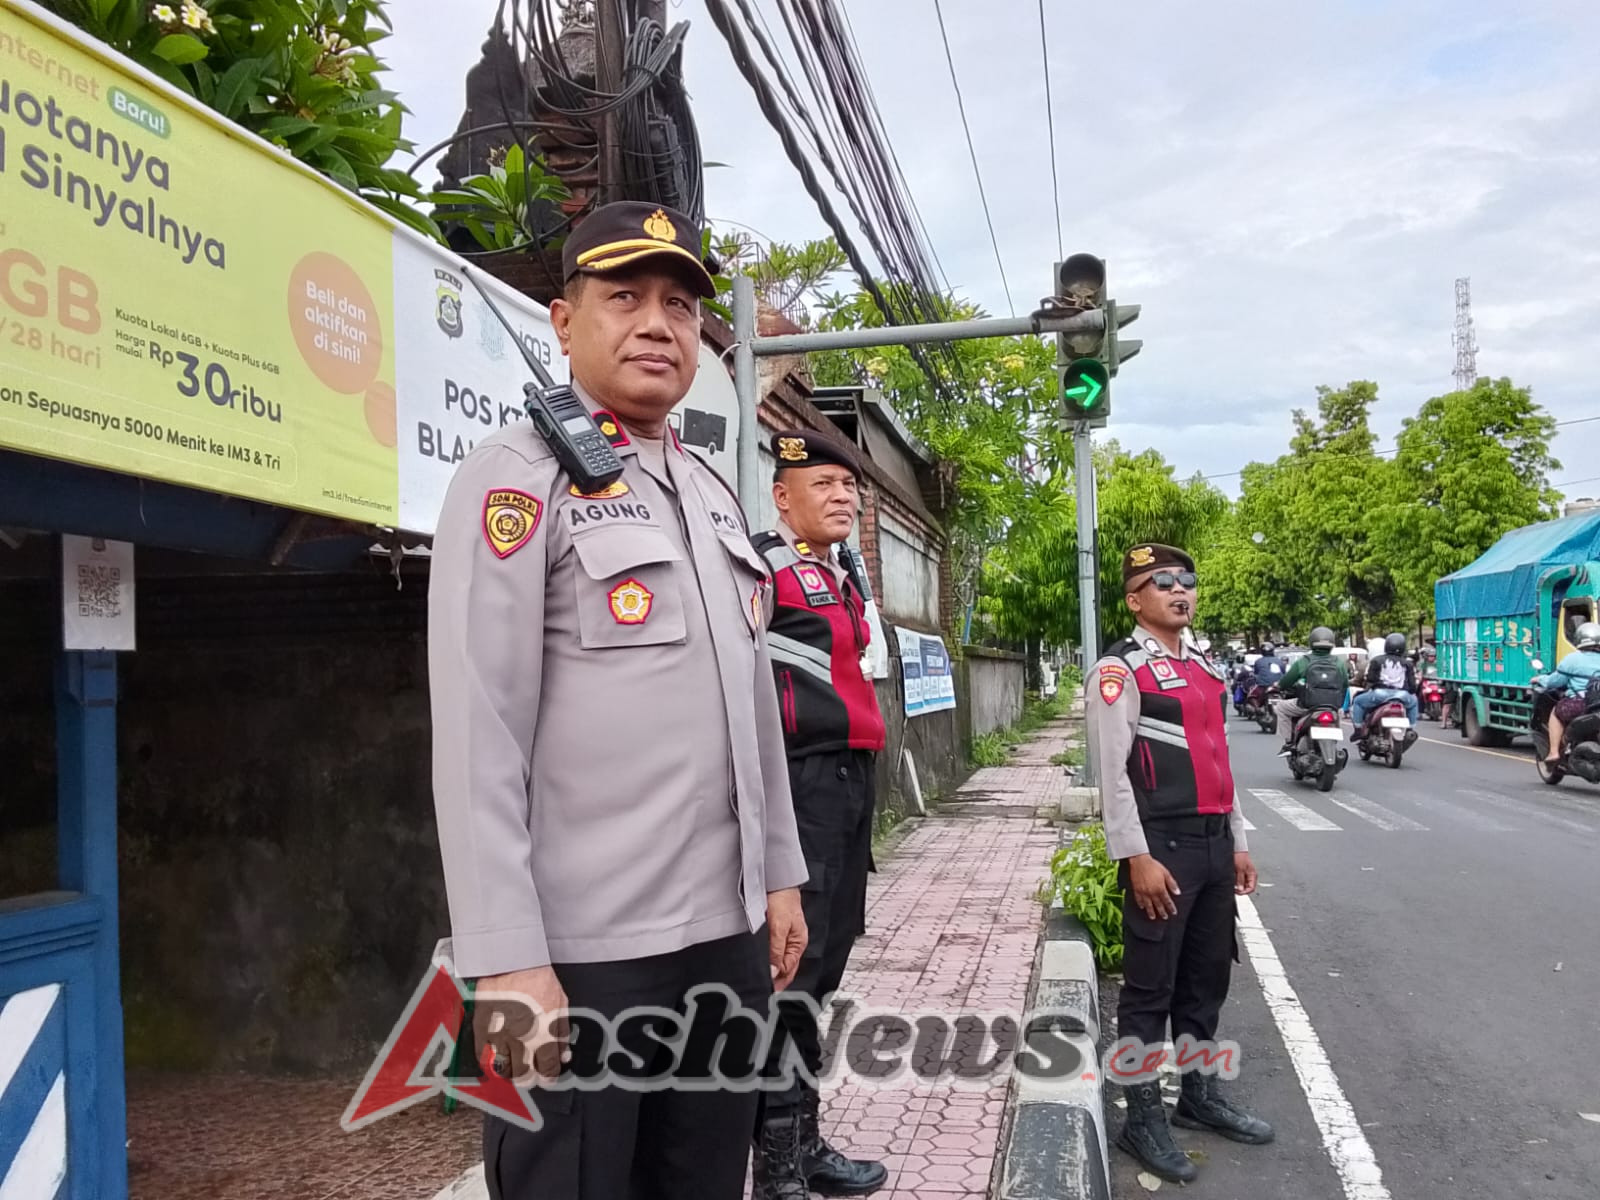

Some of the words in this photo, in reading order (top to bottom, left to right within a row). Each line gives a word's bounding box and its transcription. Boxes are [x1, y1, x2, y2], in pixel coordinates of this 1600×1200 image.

[113, 90, 166, 134] Baru!
[20, 143, 226, 270] Sinyalnya
[0, 247, 102, 335] GB
[305, 279, 335, 309] Beli
[338, 296, 367, 323] dan
[115, 329, 146, 347] Harga
[115, 307, 148, 329] Kuota
[150, 319, 179, 340] Lokal
[181, 332, 202, 347] 6GB
[212, 342, 240, 361] Kuota
[241, 353, 260, 369] Plus
[261, 360, 281, 375] 6GB
[304, 305, 368, 345] aktifkan
[51, 331, 101, 370] hari
[115, 343, 143, 359] mulai
[313, 331, 329, 352] di
[331, 339, 361, 365] sini!
[444, 378, 493, 426] POS
[27, 390, 121, 432] Sepuasnya
[124, 416, 164, 441] 5000
[166, 428, 208, 453] Menit
[209, 437, 225, 456] ke
[227, 443, 251, 463] IM3
[253, 450, 264, 466] &
[265, 453, 282, 471] Tri
[417, 420, 474, 465] BLA
[570, 503, 651, 526] AGUNG
